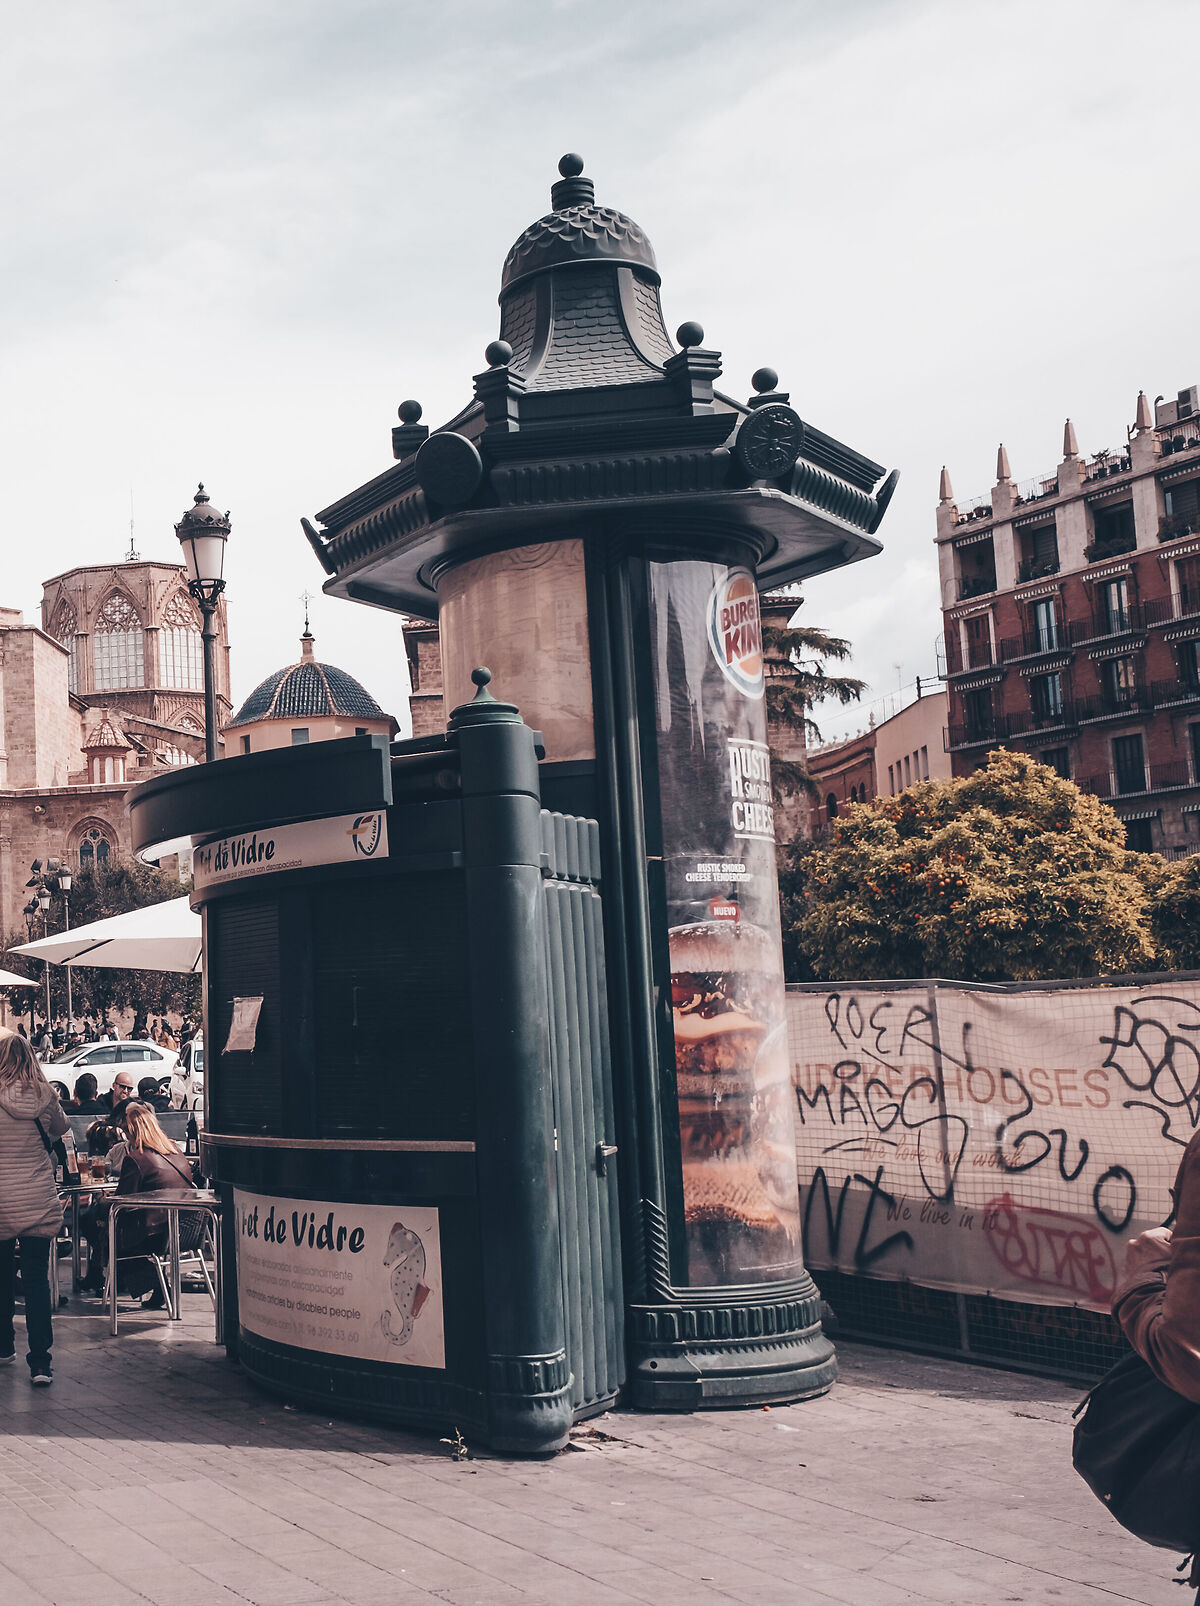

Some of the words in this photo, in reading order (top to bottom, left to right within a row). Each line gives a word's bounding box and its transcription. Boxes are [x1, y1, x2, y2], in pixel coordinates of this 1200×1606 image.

[720, 599, 760, 632] BURG
[725, 622, 762, 665] KIN
[728, 746, 770, 797] RUSTI
[732, 801, 775, 835] CHEES
[231, 834, 275, 868] Vidre
[940, 1065, 1111, 1109] HOUSES
[264, 1205, 287, 1244] de
[292, 1211, 365, 1253] Vidre
[920, 1197, 951, 1226] live
[959, 1207, 974, 1230] in
[286, 1298, 295, 1310] by
[296, 1300, 328, 1315] disabled
[329, 1306, 361, 1320] people
